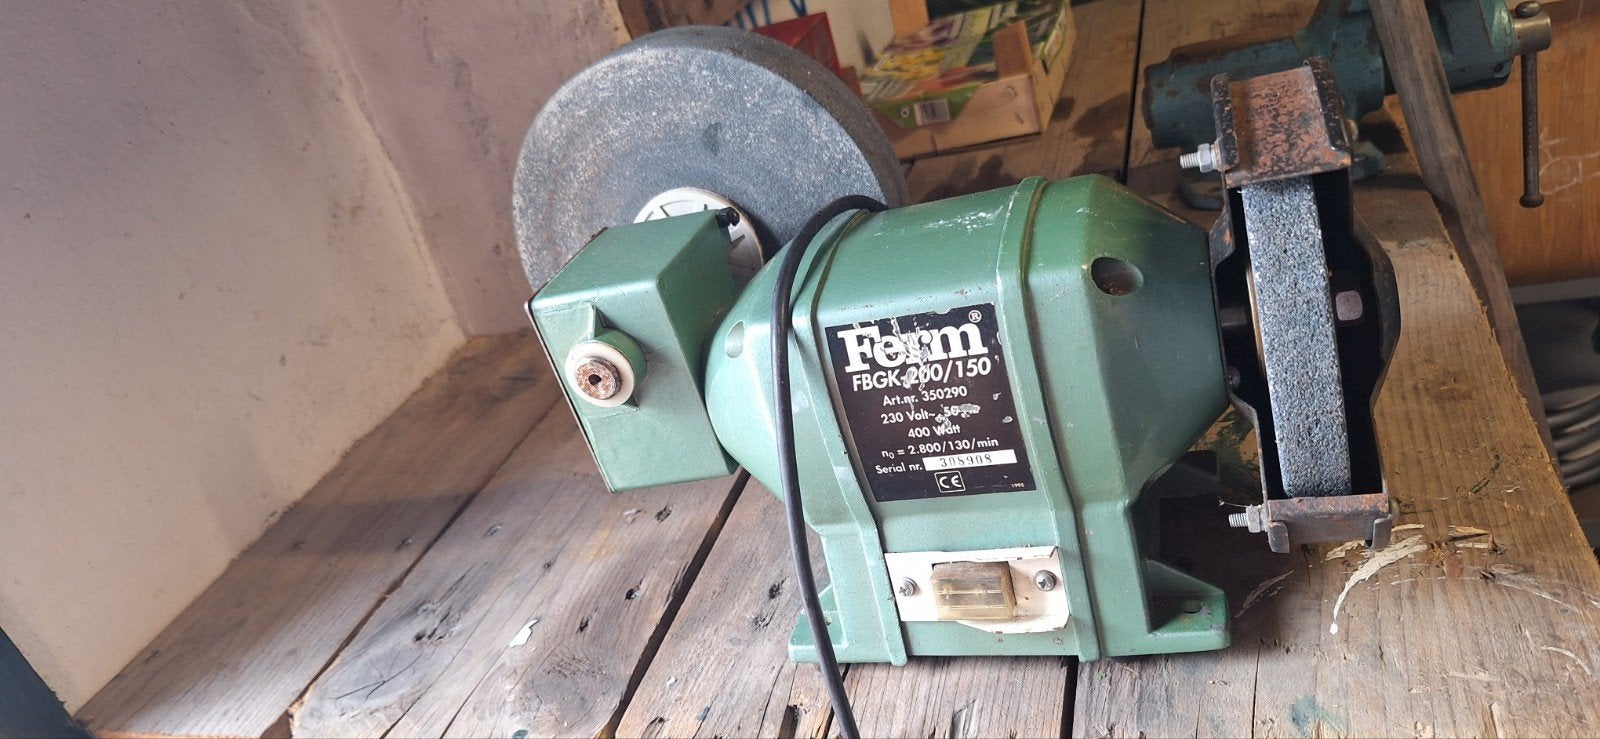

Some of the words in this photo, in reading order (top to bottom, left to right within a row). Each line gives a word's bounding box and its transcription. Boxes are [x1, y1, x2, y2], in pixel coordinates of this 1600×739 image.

[837, 323, 989, 372] Ferm
[921, 386, 968, 402] 350290
[881, 412, 904, 425] 230
[908, 427, 931, 438] 400
[933, 425, 961, 437] Watt
[907, 437, 999, 455] 2.800/130/min
[875, 462, 906, 474] Serial
[909, 462, 923, 472] nr.
